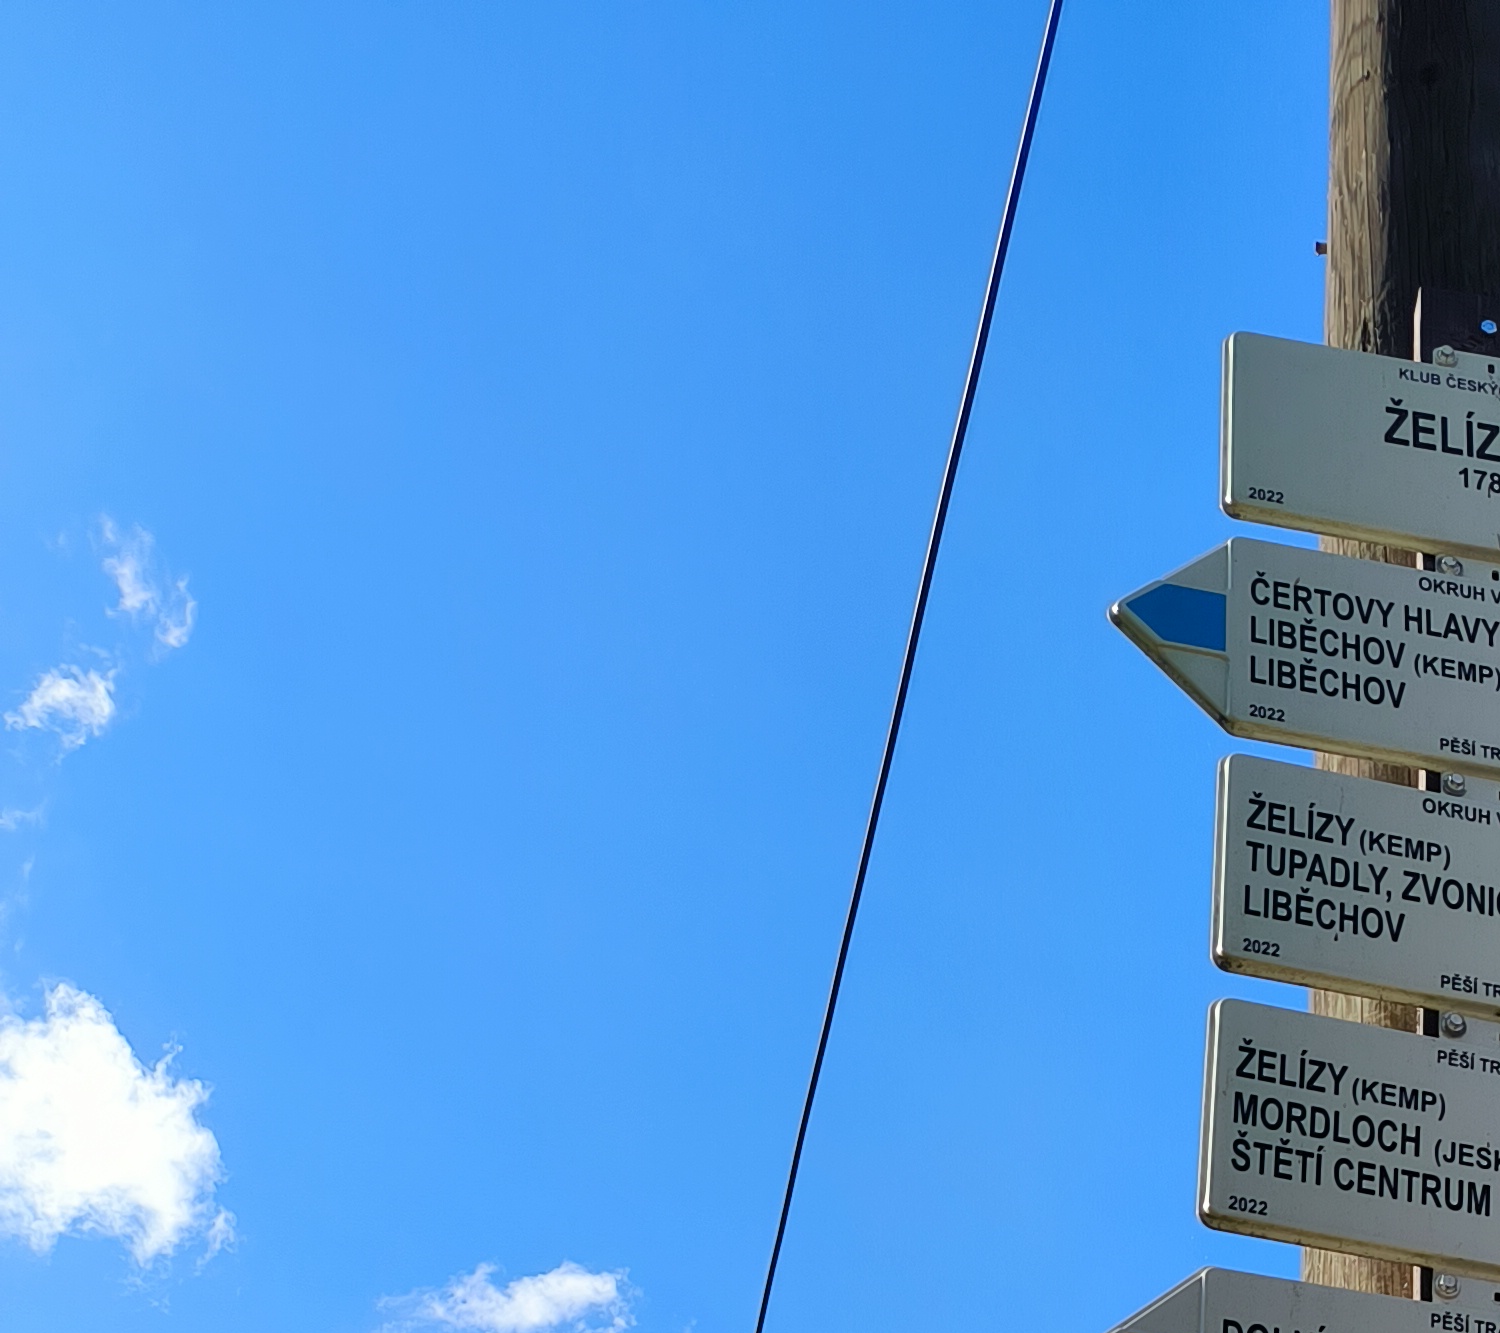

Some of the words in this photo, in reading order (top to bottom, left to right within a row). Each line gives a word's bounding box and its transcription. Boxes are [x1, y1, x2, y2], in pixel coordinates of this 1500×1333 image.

[1399, 368, 1440, 385] KLUB
[1248, 487, 1284, 504] 2022
[1418, 577, 1485, 601] OKRUH
[1251, 571, 1395, 627] ČERTOVY
[1405, 604, 1500, 647] HLAVY
[1251, 616, 1405, 668] LIBĚCHOV
[1251, 656, 1406, 708] LIBĚCHOV
[1249, 704, 1285, 722] 2022
[1440, 737, 1476, 757] PĚŠÍ
[1422, 798, 1491, 825] OKRUH
[1246, 791, 1355, 846] ŽELÍZY
[1359, 829, 1451, 871] (KEMP)
[1246, 840, 1392, 903] TUPADLY,
[1244, 885, 1405, 942] LIBĚCHOV
[1243, 937, 1280, 957] 2022
[1440, 974, 1478, 994] PĚŠÍ
[1437, 1048, 1475, 1069] PĚŠÍ
[1236, 1037, 1349, 1096] ŽELÍZY
[1352, 1077, 1446, 1121] (KEMP)
[1233, 1091, 1421, 1157] MORDLOCH
[1231, 1130, 1327, 1186] ŠTĚTÍ
[1333, 1157, 1491, 1217] CENTRUM
[1228, 1195, 1268, 1216] 2022
[1430, 1312, 1469, 1333] PĚŠÍ
